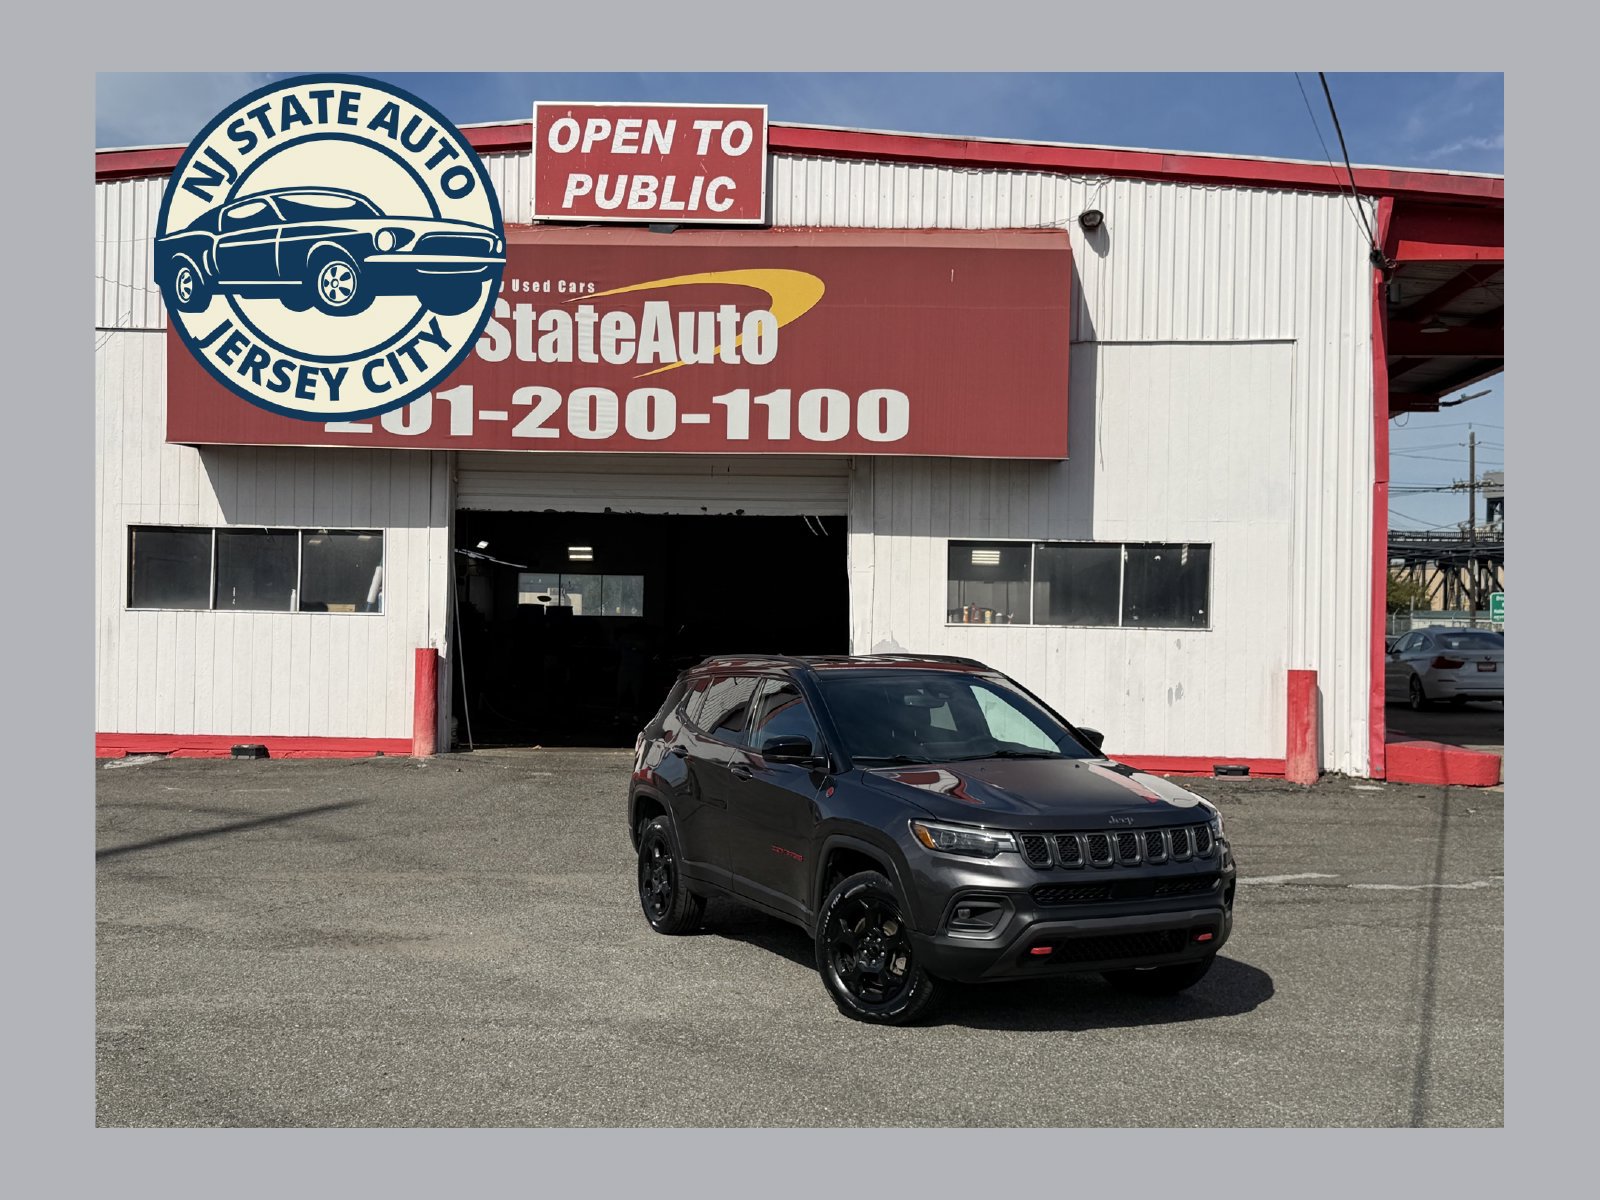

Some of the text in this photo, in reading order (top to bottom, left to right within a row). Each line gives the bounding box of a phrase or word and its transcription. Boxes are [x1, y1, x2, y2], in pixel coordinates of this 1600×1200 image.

[547, 117, 753, 157] OPEN TO
[561, 173, 737, 213] PUBLIC
[511, 279, 551, 293] Used
[558, 279, 595, 293] Cars
[324, 384, 910, 442] 01-200-1100
